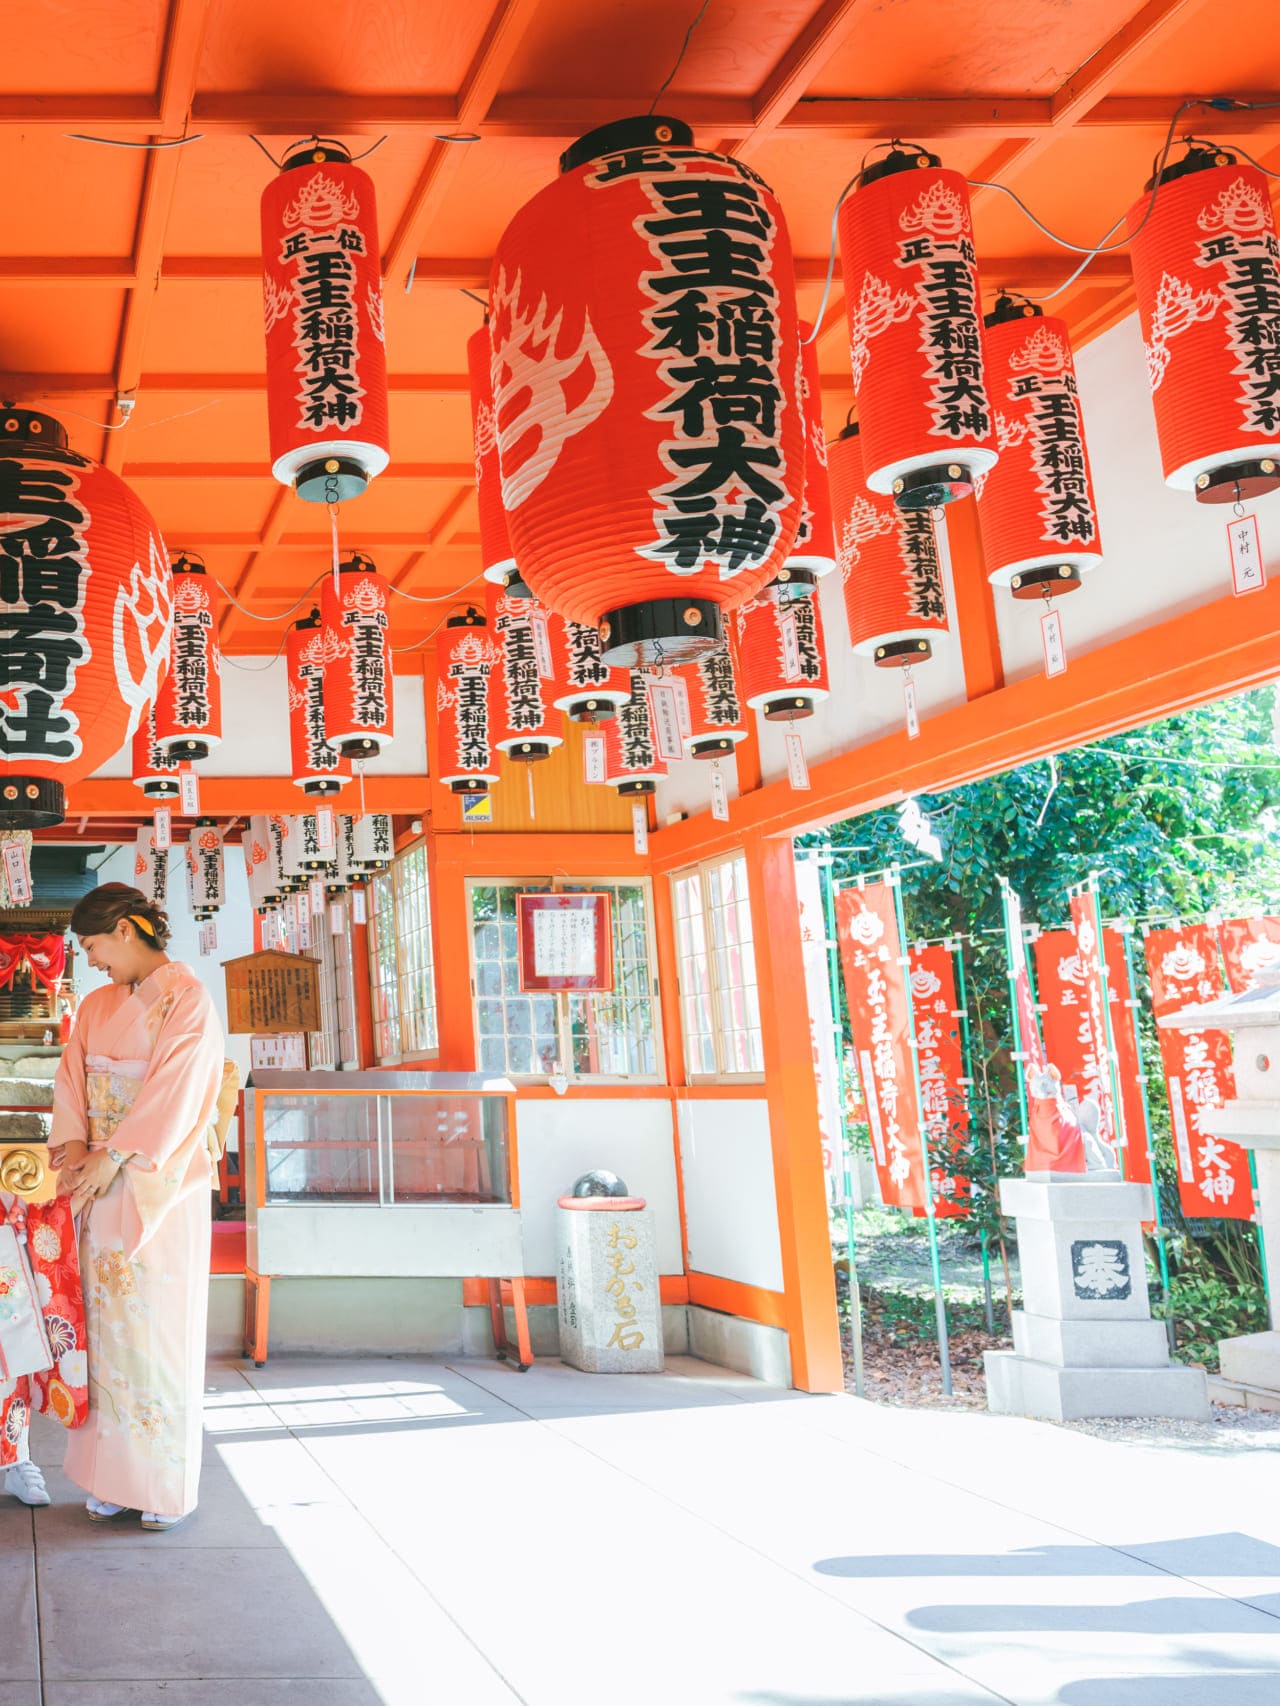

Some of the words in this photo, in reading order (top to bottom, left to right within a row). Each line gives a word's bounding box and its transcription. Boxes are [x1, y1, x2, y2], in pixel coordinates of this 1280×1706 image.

[284, 229, 362, 260] 正一位
[902, 239, 975, 264] 正一位
[294, 250, 357, 426] 玉主稲荷大神
[644, 180, 782, 569] 玉主稲荷大神
[923, 260, 988, 435] 玉主稲荷大神
[1015, 376, 1077, 400] 正一位
[1034, 390, 1092, 540] 玉主稲荷大神
[902, 508, 946, 619] 主稲荷大神
[345, 612, 386, 627] 正一位
[569, 622, 607, 684] 荷大神
[176, 625, 206, 724] 玉主稲荷大神
[299, 664, 323, 677] 正一
[355, 626, 384, 723] 玉主稲荷大神
[451, 665, 489, 678] 正一位
[705, 642, 738, 723] 稲荷大神
[460, 677, 487, 767] 玉主稲荷大神
[1165, 980, 1214, 1001] 正一位
[865, 968, 911, 1190] 玉主稲荷大神
[606, 1222, 646, 1351] おもかる石
[1077, 1244, 1128, 1295] 奉
